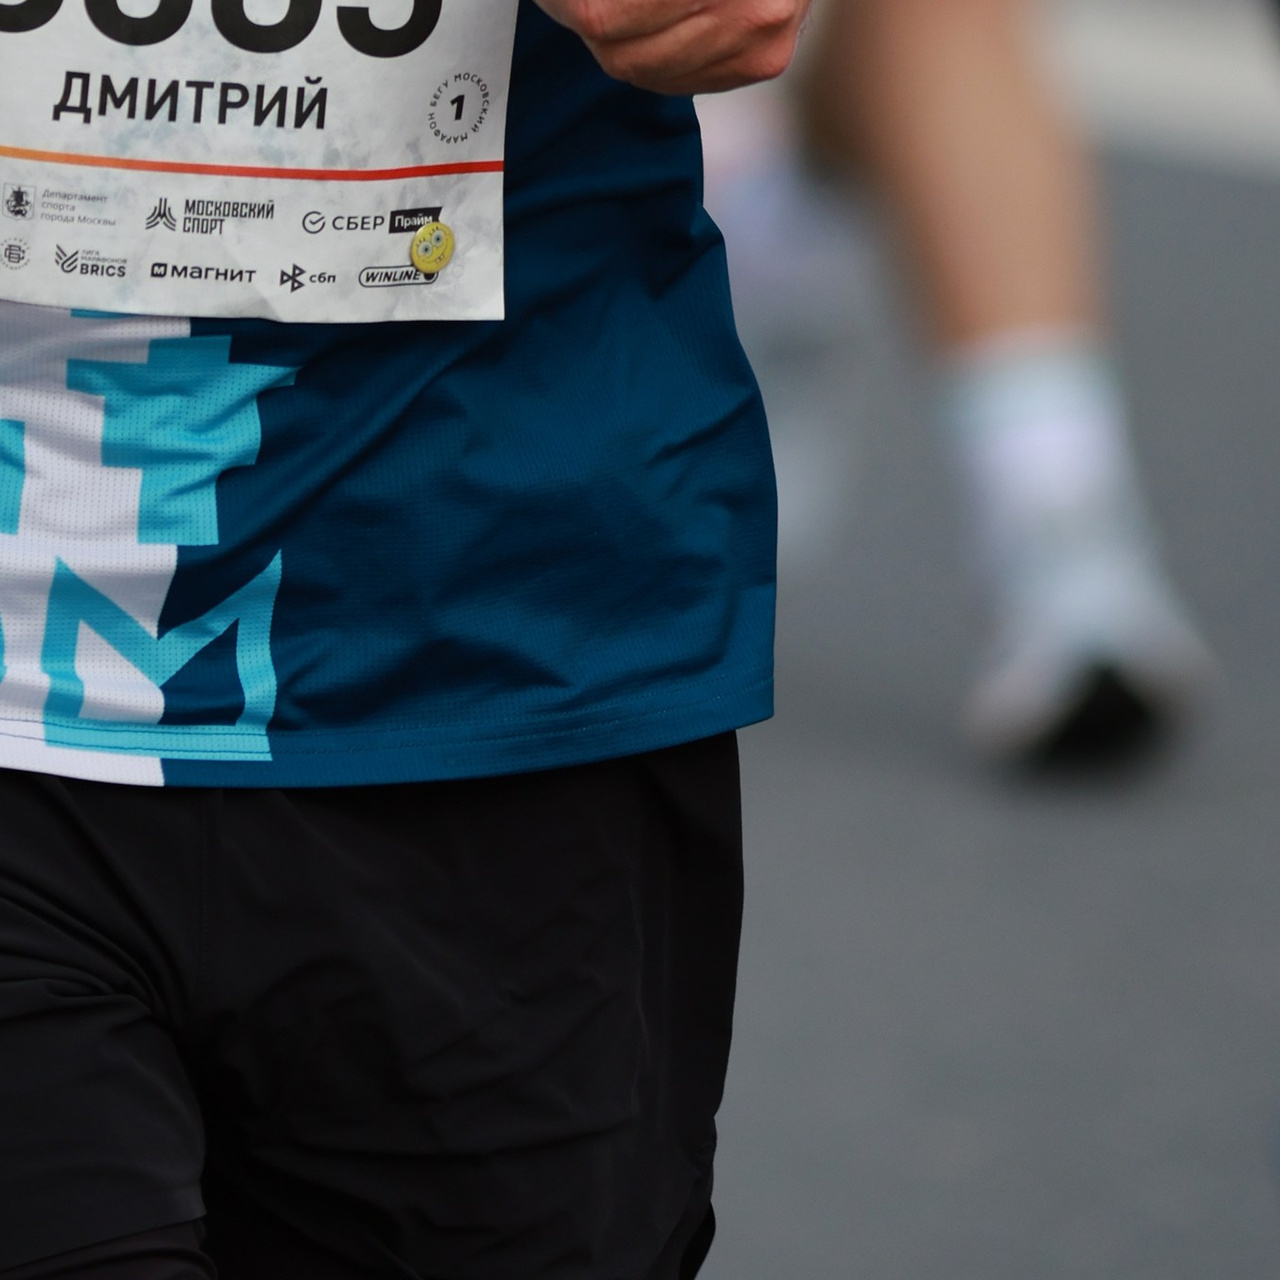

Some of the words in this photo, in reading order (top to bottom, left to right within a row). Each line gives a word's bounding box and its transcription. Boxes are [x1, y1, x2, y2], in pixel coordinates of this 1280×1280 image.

[52, 71, 328, 130] ДМИТРИЙ
[450, 94, 465, 121] 1
[42, 189, 108, 203] Департамент
[41, 201, 75, 212] спорта
[184, 199, 275, 220] МОСКОВСКИЙ
[40, 212, 75, 223] города
[77, 215, 116, 226] Москвы
[182, 216, 225, 235] СПОРТ
[331, 215, 385, 231] СБЕР
[394, 213, 433, 230] Прайм
[80, 263, 126, 278] BRICS
[365, 269, 420, 283] WINLINE
